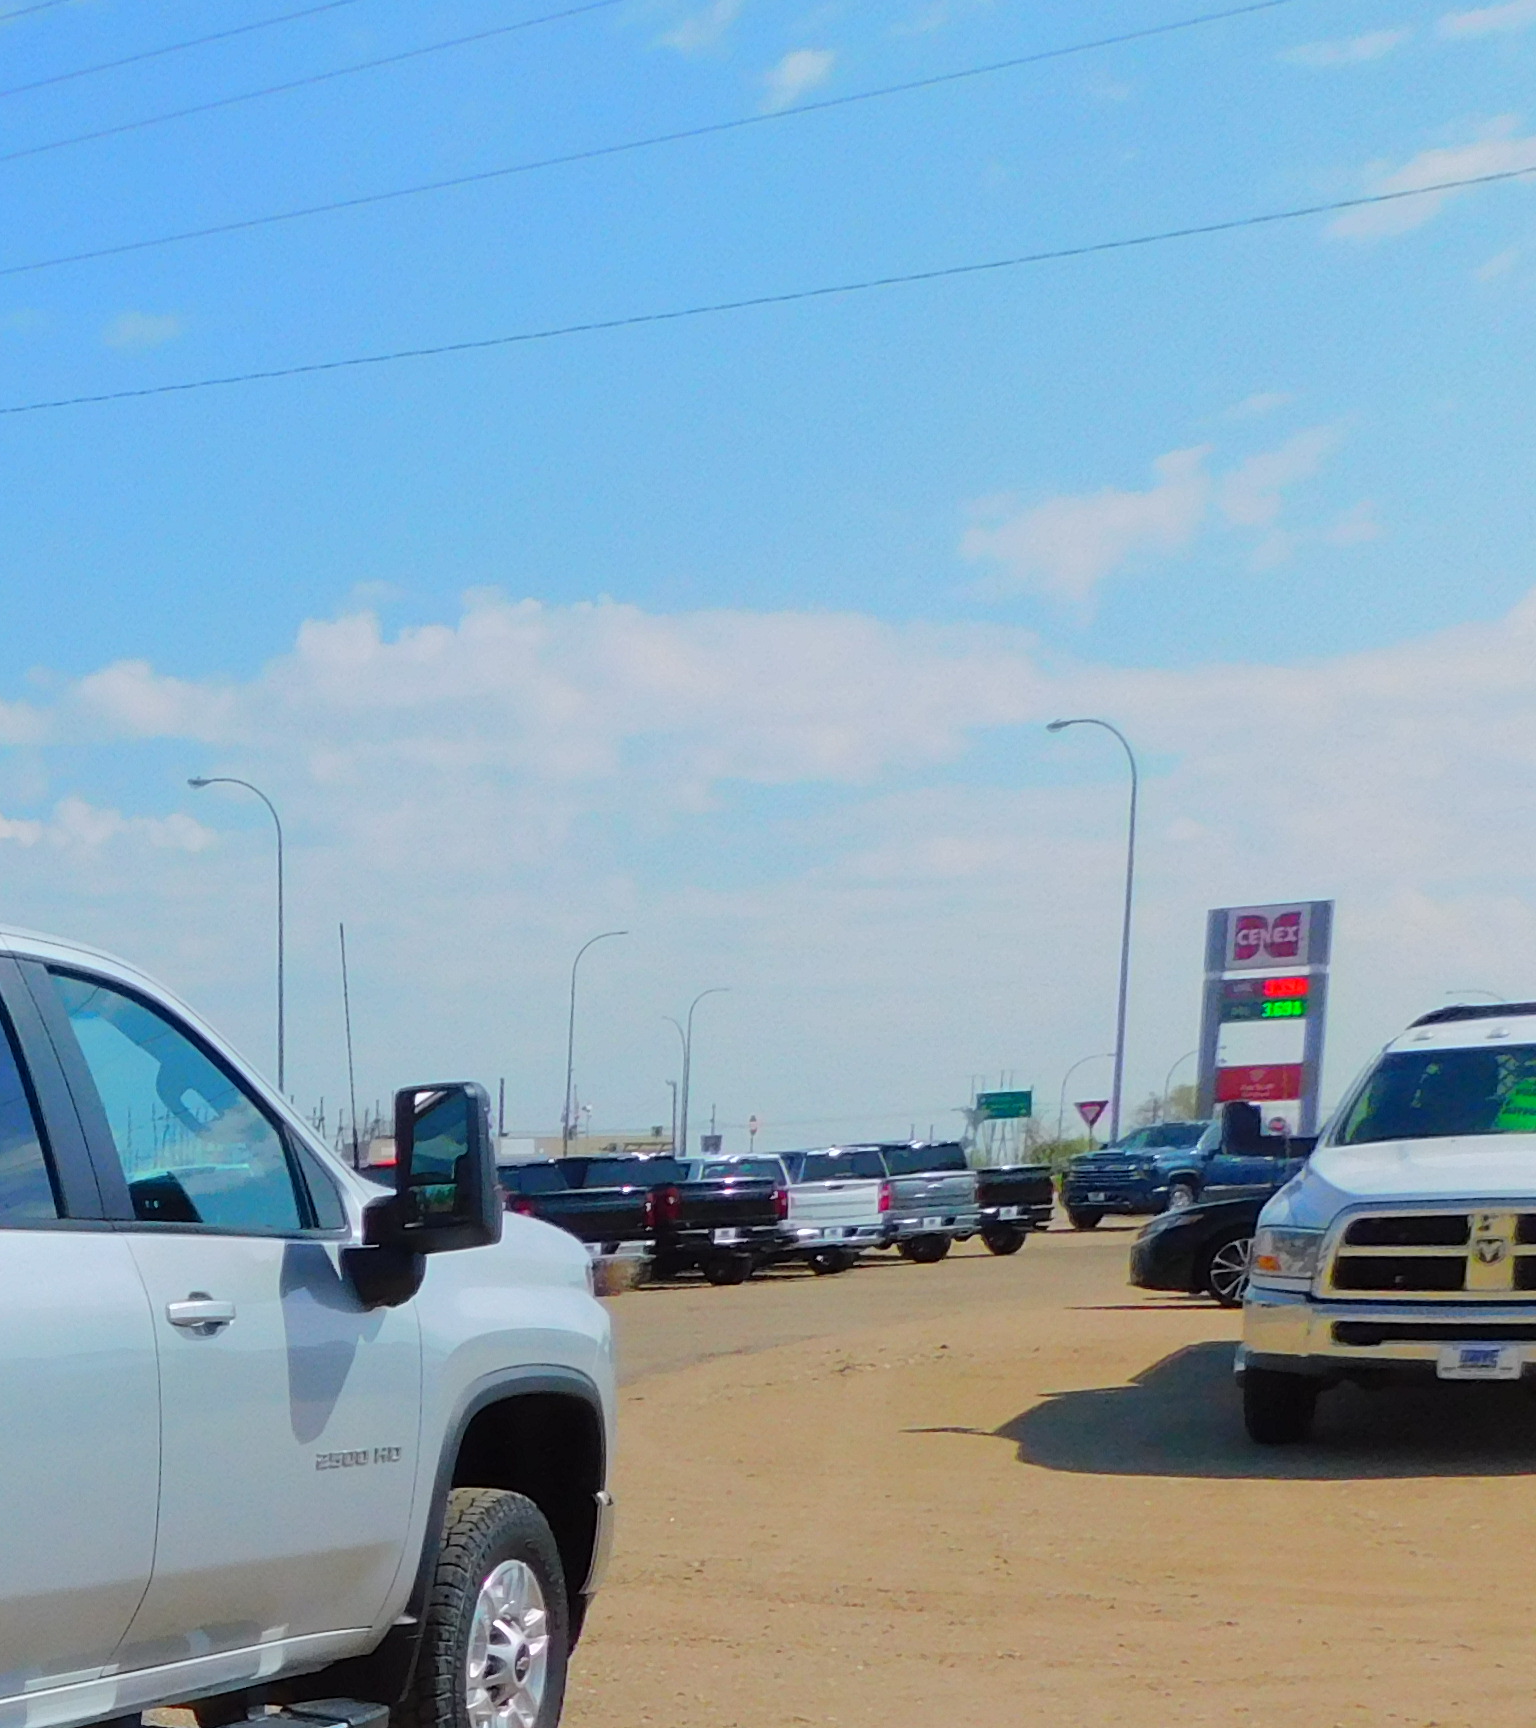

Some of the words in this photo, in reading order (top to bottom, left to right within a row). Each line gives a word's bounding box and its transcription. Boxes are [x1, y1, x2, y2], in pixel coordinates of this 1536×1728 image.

[1235, 925, 1299, 947] CENEX
[315, 1449, 369, 1471] 2500
[374, 1446, 402, 1464] HD
